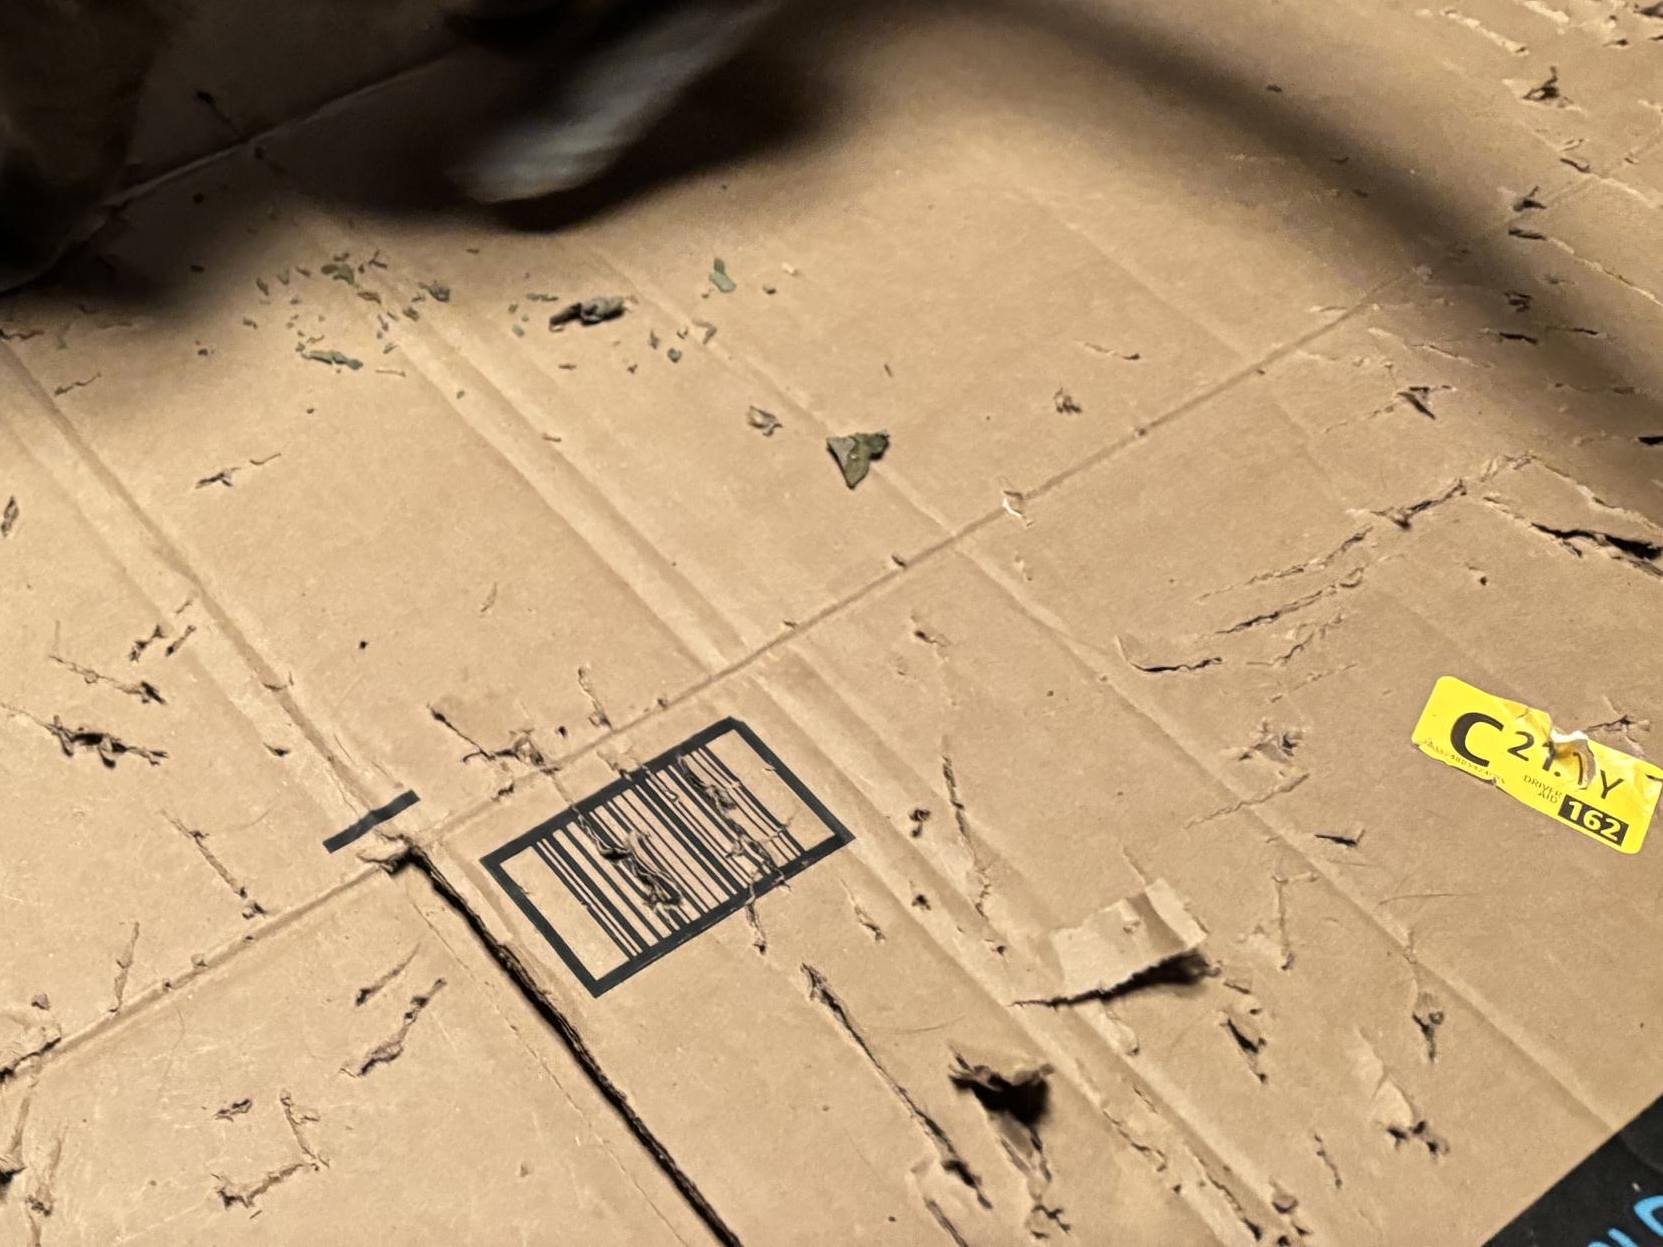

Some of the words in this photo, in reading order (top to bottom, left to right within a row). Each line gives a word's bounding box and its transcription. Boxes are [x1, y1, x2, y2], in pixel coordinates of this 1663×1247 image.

[1450, 712, 1504, 768] C
[1524, 774, 1563, 798] DRIVER
[1538, 790, 1558, 804] AID
[1568, 801, 1622, 842] 162
